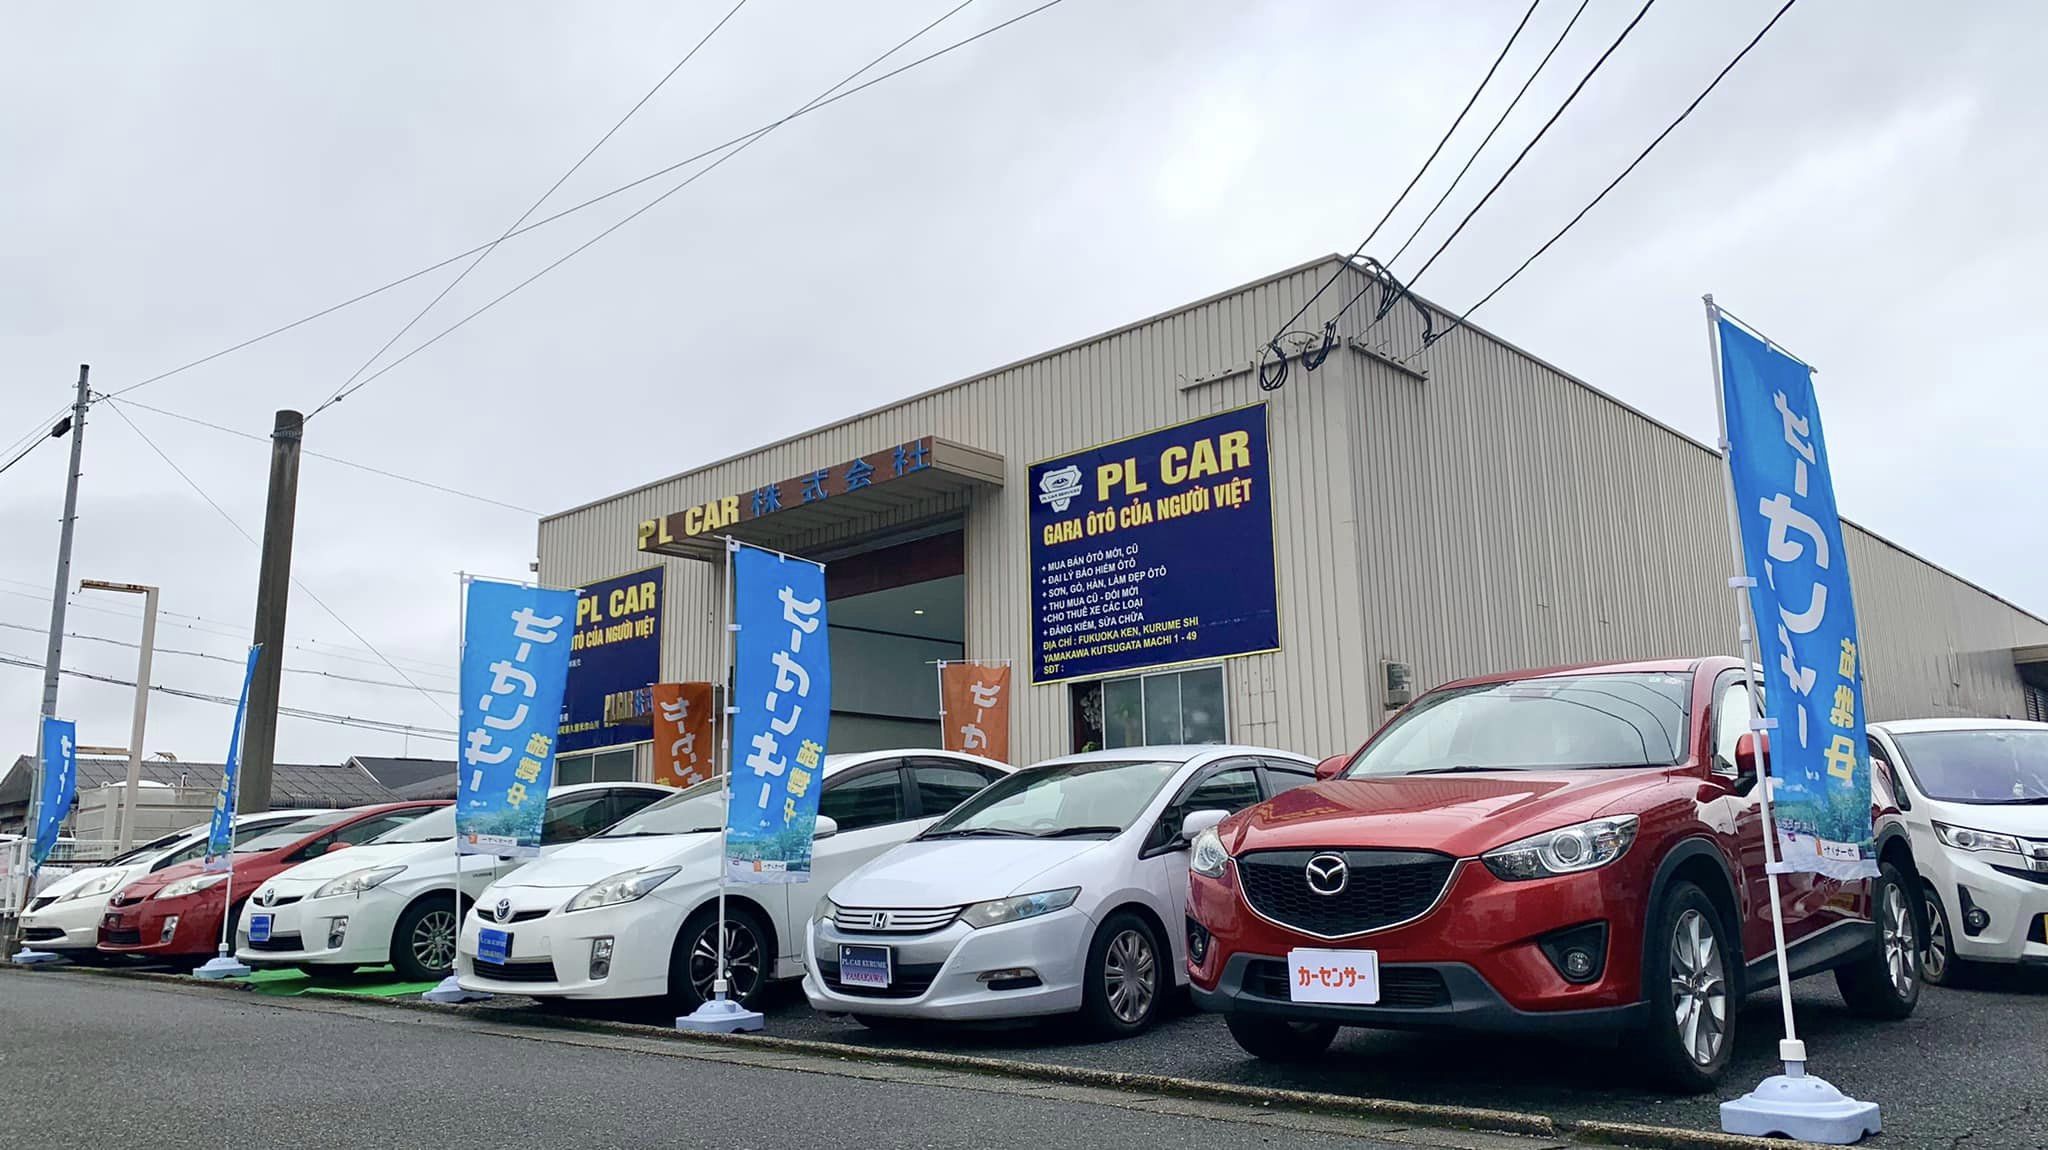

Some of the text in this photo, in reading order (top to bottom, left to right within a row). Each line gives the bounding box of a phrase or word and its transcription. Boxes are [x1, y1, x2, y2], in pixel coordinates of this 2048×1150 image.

[1097, 430, 1250, 502] PL CAR
[639, 439, 932, 550] PL CAR 株式会社
[1043, 476, 1252, 546] GARA ÔTÔ CỦA NGƯỜI VIỆT
[1048, 560, 1066, 572] MUA
[1067, 554, 1084, 568] BÁN
[1086, 551, 1104, 564] ÔTÔ
[1126, 543, 1138, 556] CŨ
[1064, 570, 1074, 582] LÝ
[1118, 558, 1136, 571] ÔTÔ
[1108, 574, 1126, 586] LÀM
[1148, 565, 1167, 578] ÔTÔ
[576, 581, 656, 626] PL CAR
[1047, 612, 1064, 624] CHO
[1090, 605, 1100, 615] XE
[1102, 600, 1120, 613] CÁC
[1050, 600, 1065, 611] THU
[1066, 595, 1085, 607] MUA
[1086, 592, 1098, 604] CŨ
[570, 630, 584, 652] TÔ
[586, 624, 604, 648] CỦA
[635, 616, 656, 639] VIỆT
[1078, 630, 1119, 645] FUKUOKA
[1143, 621, 1182, 634] KURUME
[1183, 616, 1199, 627] SHI
[1043, 646, 1090, 663] YAMAKAWA
[1091, 638, 1142, 657] KUTSUGATA
[1144, 634, 1172, 648] MACHI
[1186, 631, 1197, 641] 49
[1298, 966, 1366, 990] カーセンサー
